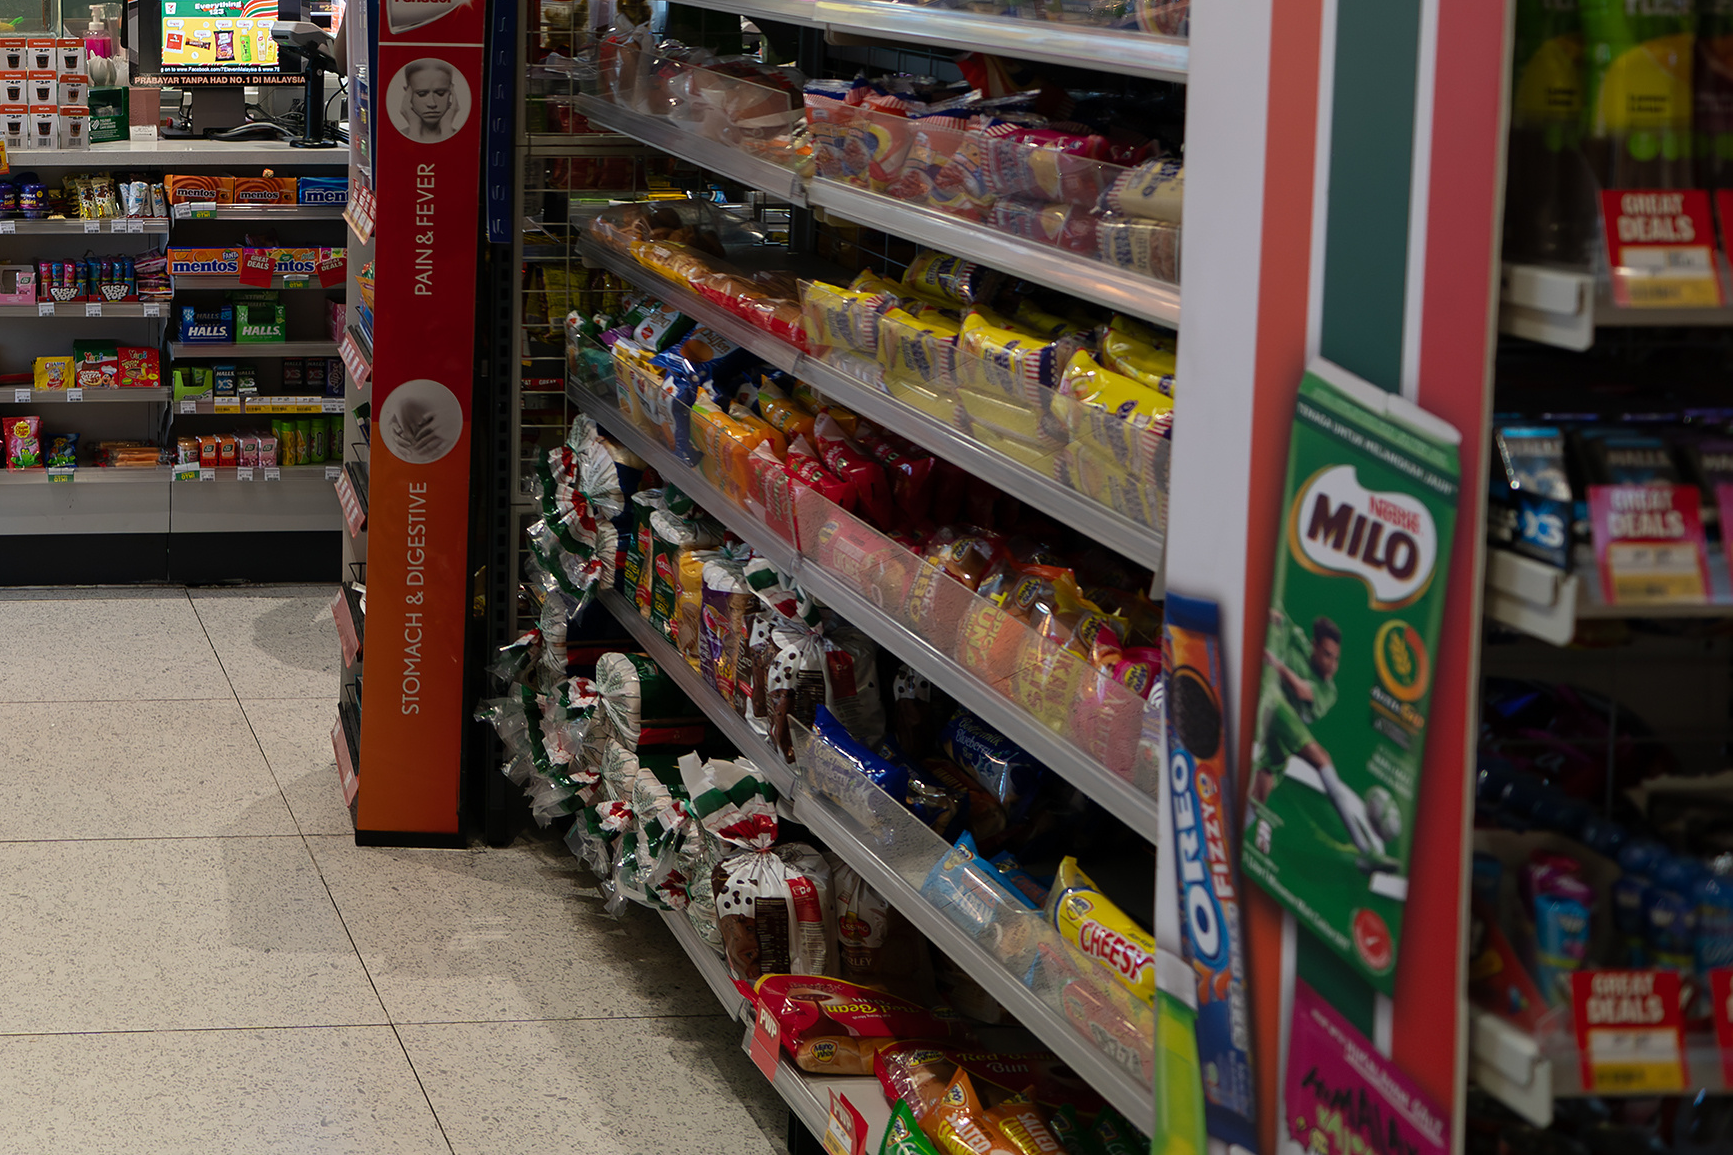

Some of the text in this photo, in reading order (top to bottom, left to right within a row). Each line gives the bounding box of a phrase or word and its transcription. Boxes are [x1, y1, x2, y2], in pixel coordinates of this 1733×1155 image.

[194, 1, 243, 11] Everything
[209, 8, 225, 16] 123
[134, 76, 306, 84] PRABAYAR TANPA HAD NO.1 DI MALAYSIA
[176, 188, 217, 198] mentos
[239, 191, 280, 200] mentos
[1620, 193, 1685, 217] GREAT
[414, 162, 436, 296] PAIN & FEVER
[1616, 217, 1696, 244] DEALS
[246, 260, 270, 270] DEALS
[250, 255, 270, 263] GREAT
[172, 259, 239, 273] mentos
[50, 286, 80, 296] PUSH
[188, 326, 228, 337] HALLS
[242, 325, 282, 337] HALLS
[1306, 492, 1421, 582] MILO
[401, 481, 428, 715] STOMACH & DIGESTIVE
[1170, 752, 1220, 960] OREO
[1199, 800, 1236, 902] FIZZY
[987, 1061, 1029, 1074] Bun
